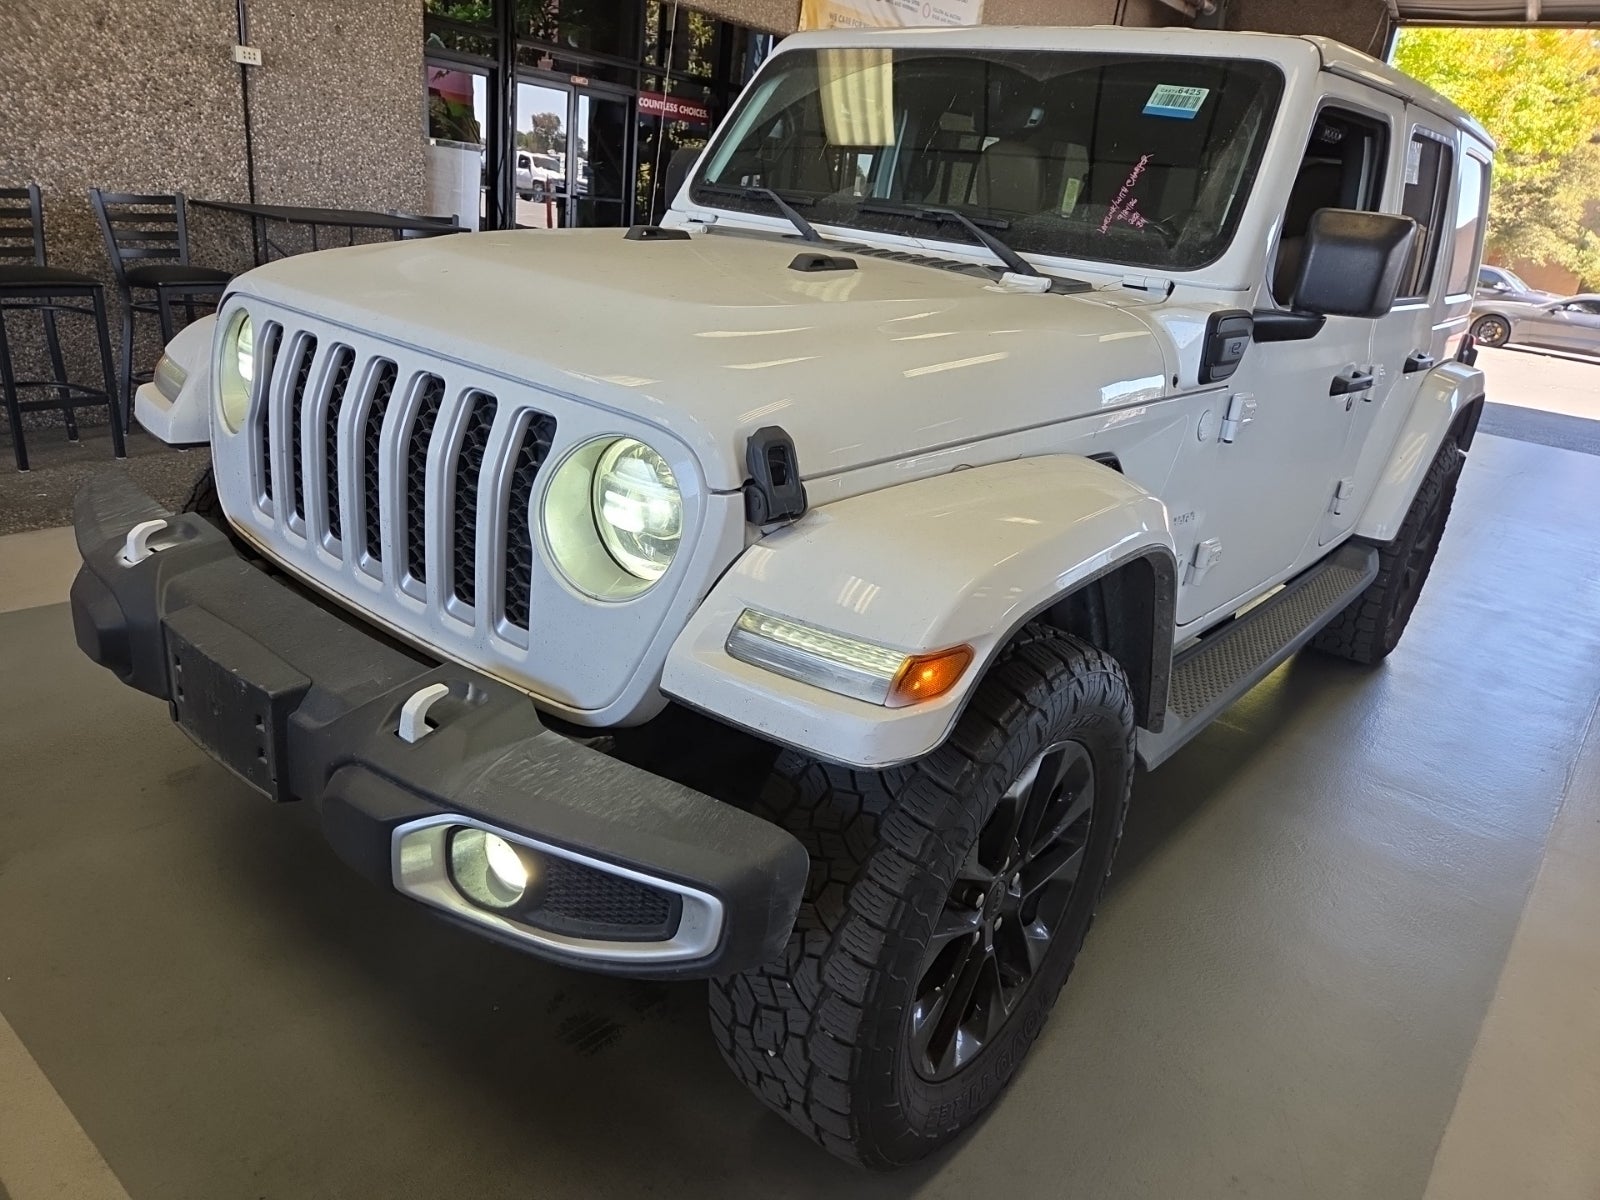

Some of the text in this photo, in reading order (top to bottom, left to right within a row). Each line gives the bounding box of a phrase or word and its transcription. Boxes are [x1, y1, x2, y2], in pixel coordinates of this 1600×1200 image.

[1178, 87, 1201, 96] 6425
[639, 97, 708, 118] COUNTLESS CHOICES.
